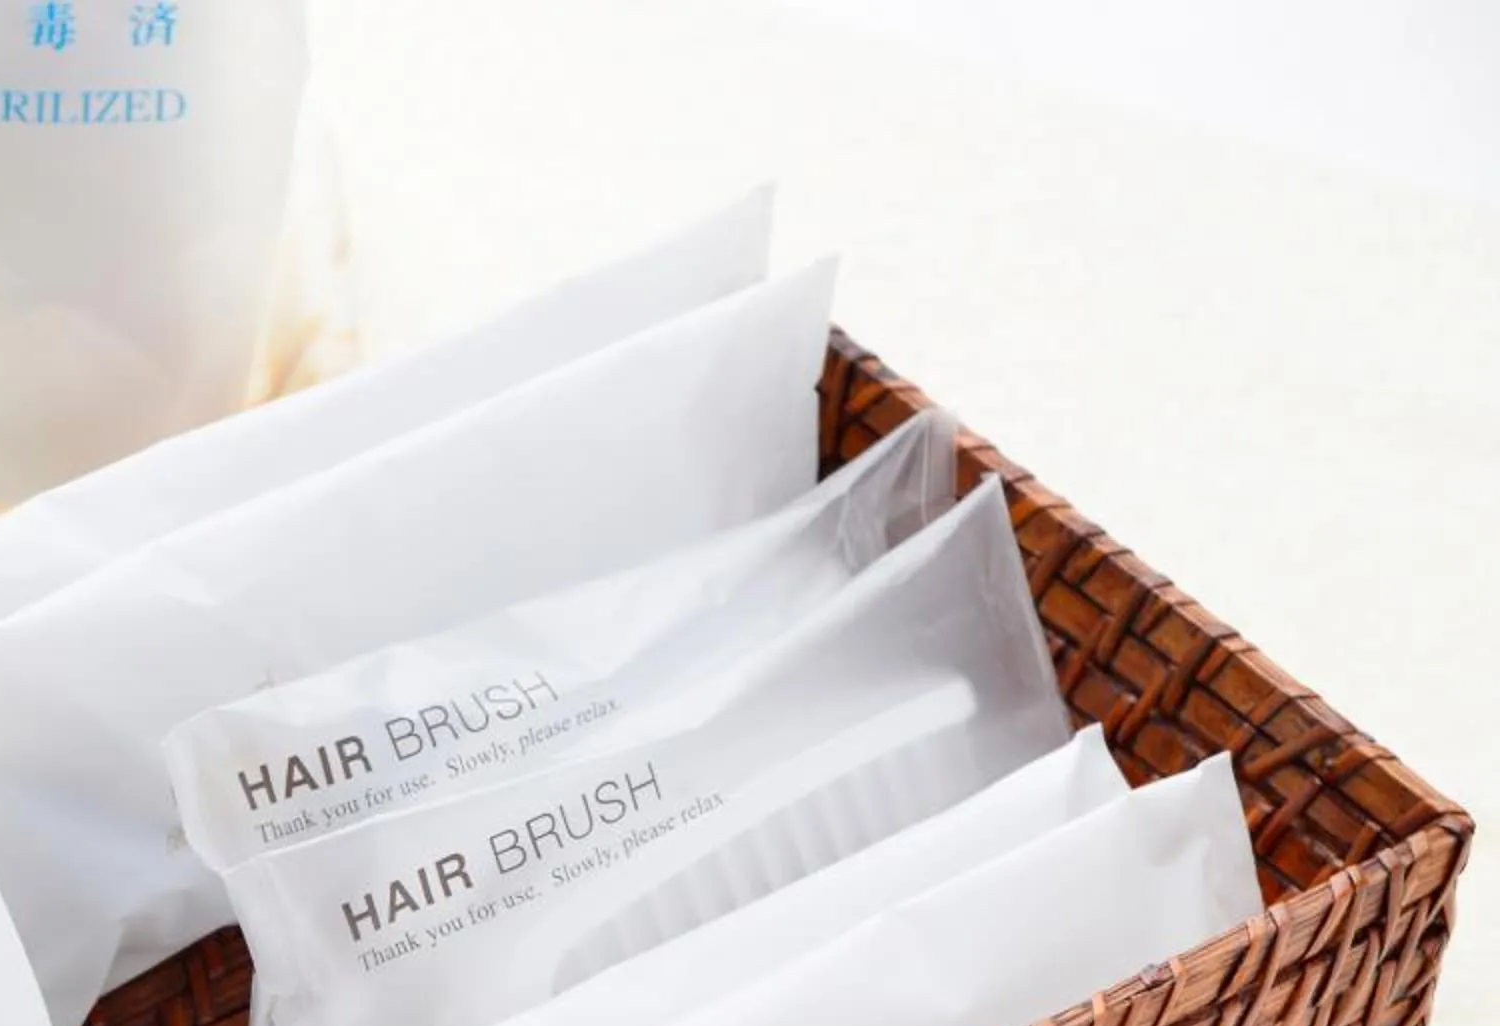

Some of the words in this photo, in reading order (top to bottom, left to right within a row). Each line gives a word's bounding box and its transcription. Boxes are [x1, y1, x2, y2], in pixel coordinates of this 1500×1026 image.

[237, 735, 373, 811] HAIR
[384, 670, 559, 762] BRUSH
[255, 813, 317, 845] Thank
[321, 799, 360, 828] you
[364, 786, 394, 817] for
[399, 776, 436, 799] use.
[445, 743, 516, 780] Slowly,
[518, 719, 572, 754] please
[340, 851, 474, 942] HAIR
[488, 761, 663, 876] BRUSH
[357, 932, 421, 974] Thank
[425, 921, 464, 948] you
[467, 902, 498, 926] for
[501, 888, 542, 910] use.
[550, 852, 620, 888] Slowly,
[622, 818, 677, 859] please
